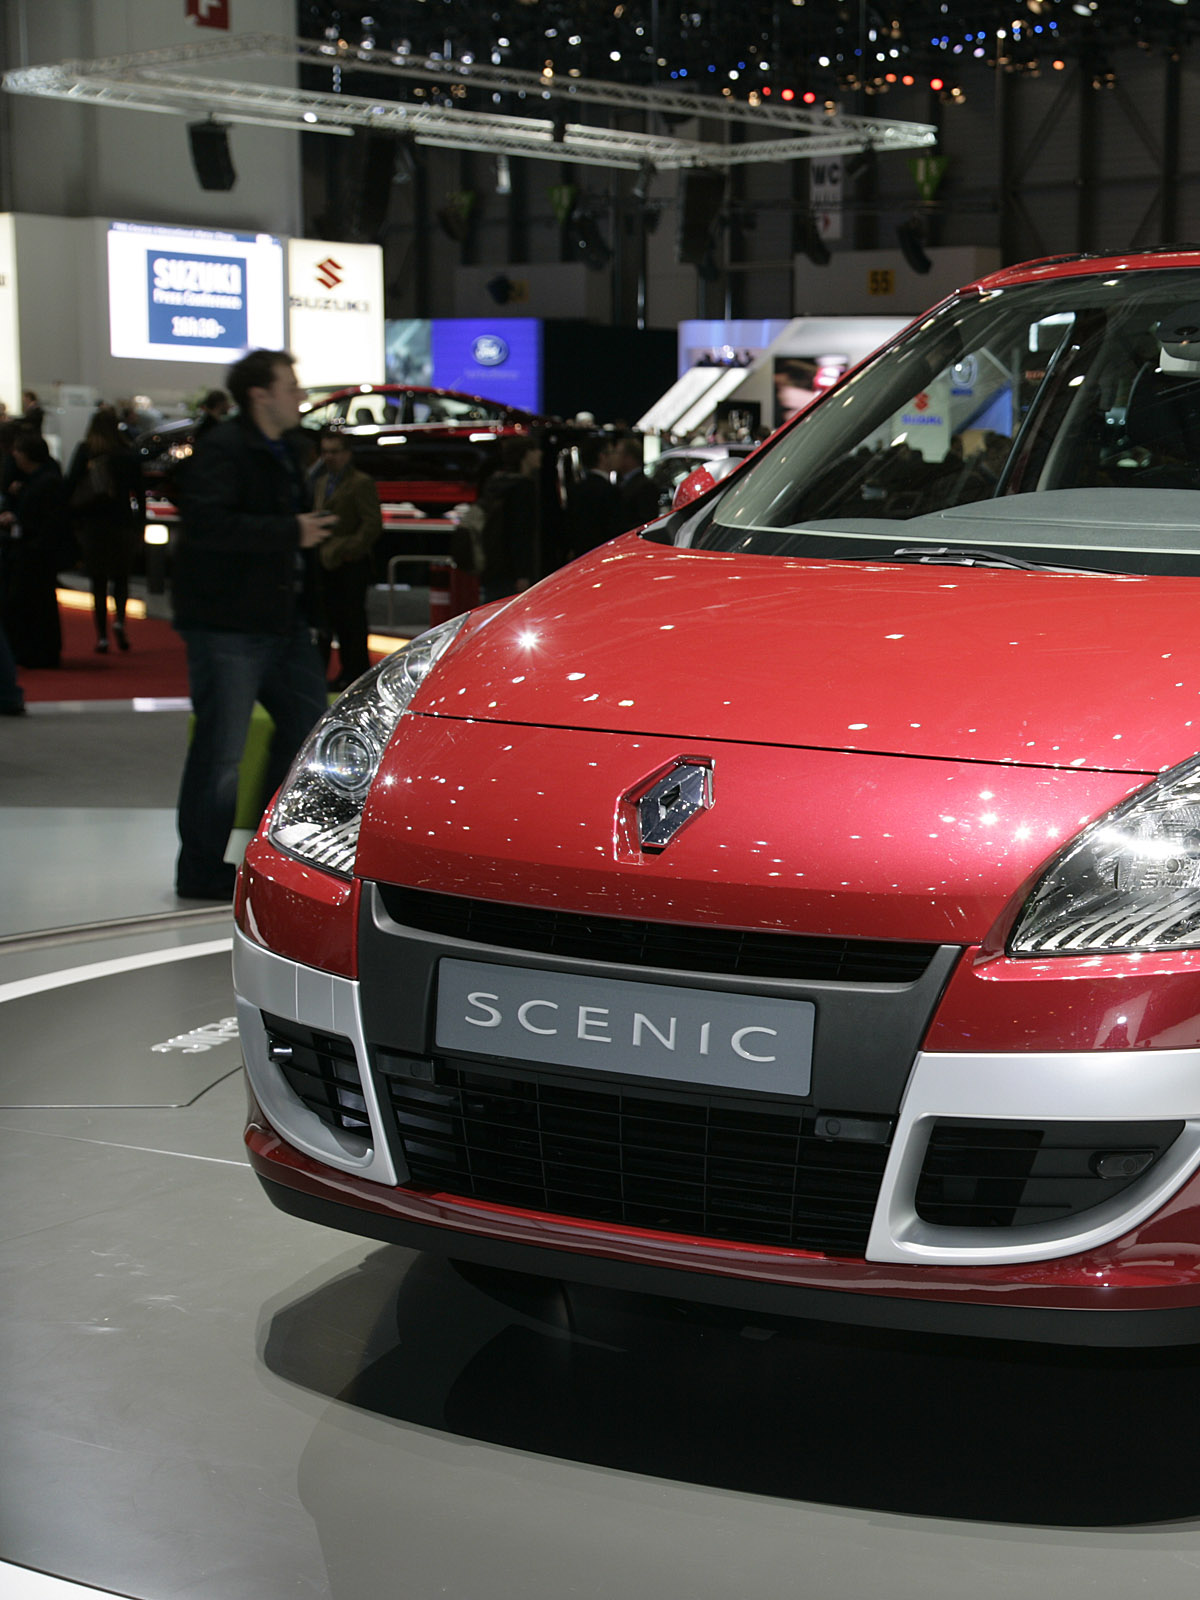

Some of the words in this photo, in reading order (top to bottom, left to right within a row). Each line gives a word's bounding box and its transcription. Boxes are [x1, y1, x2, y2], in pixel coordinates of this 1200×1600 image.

[811, 163, 839, 185] WC
[153, 258, 241, 295] SUZUKI
[289, 296, 370, 313] SUZUKI
[465, 991, 777, 1062] SCENIC
